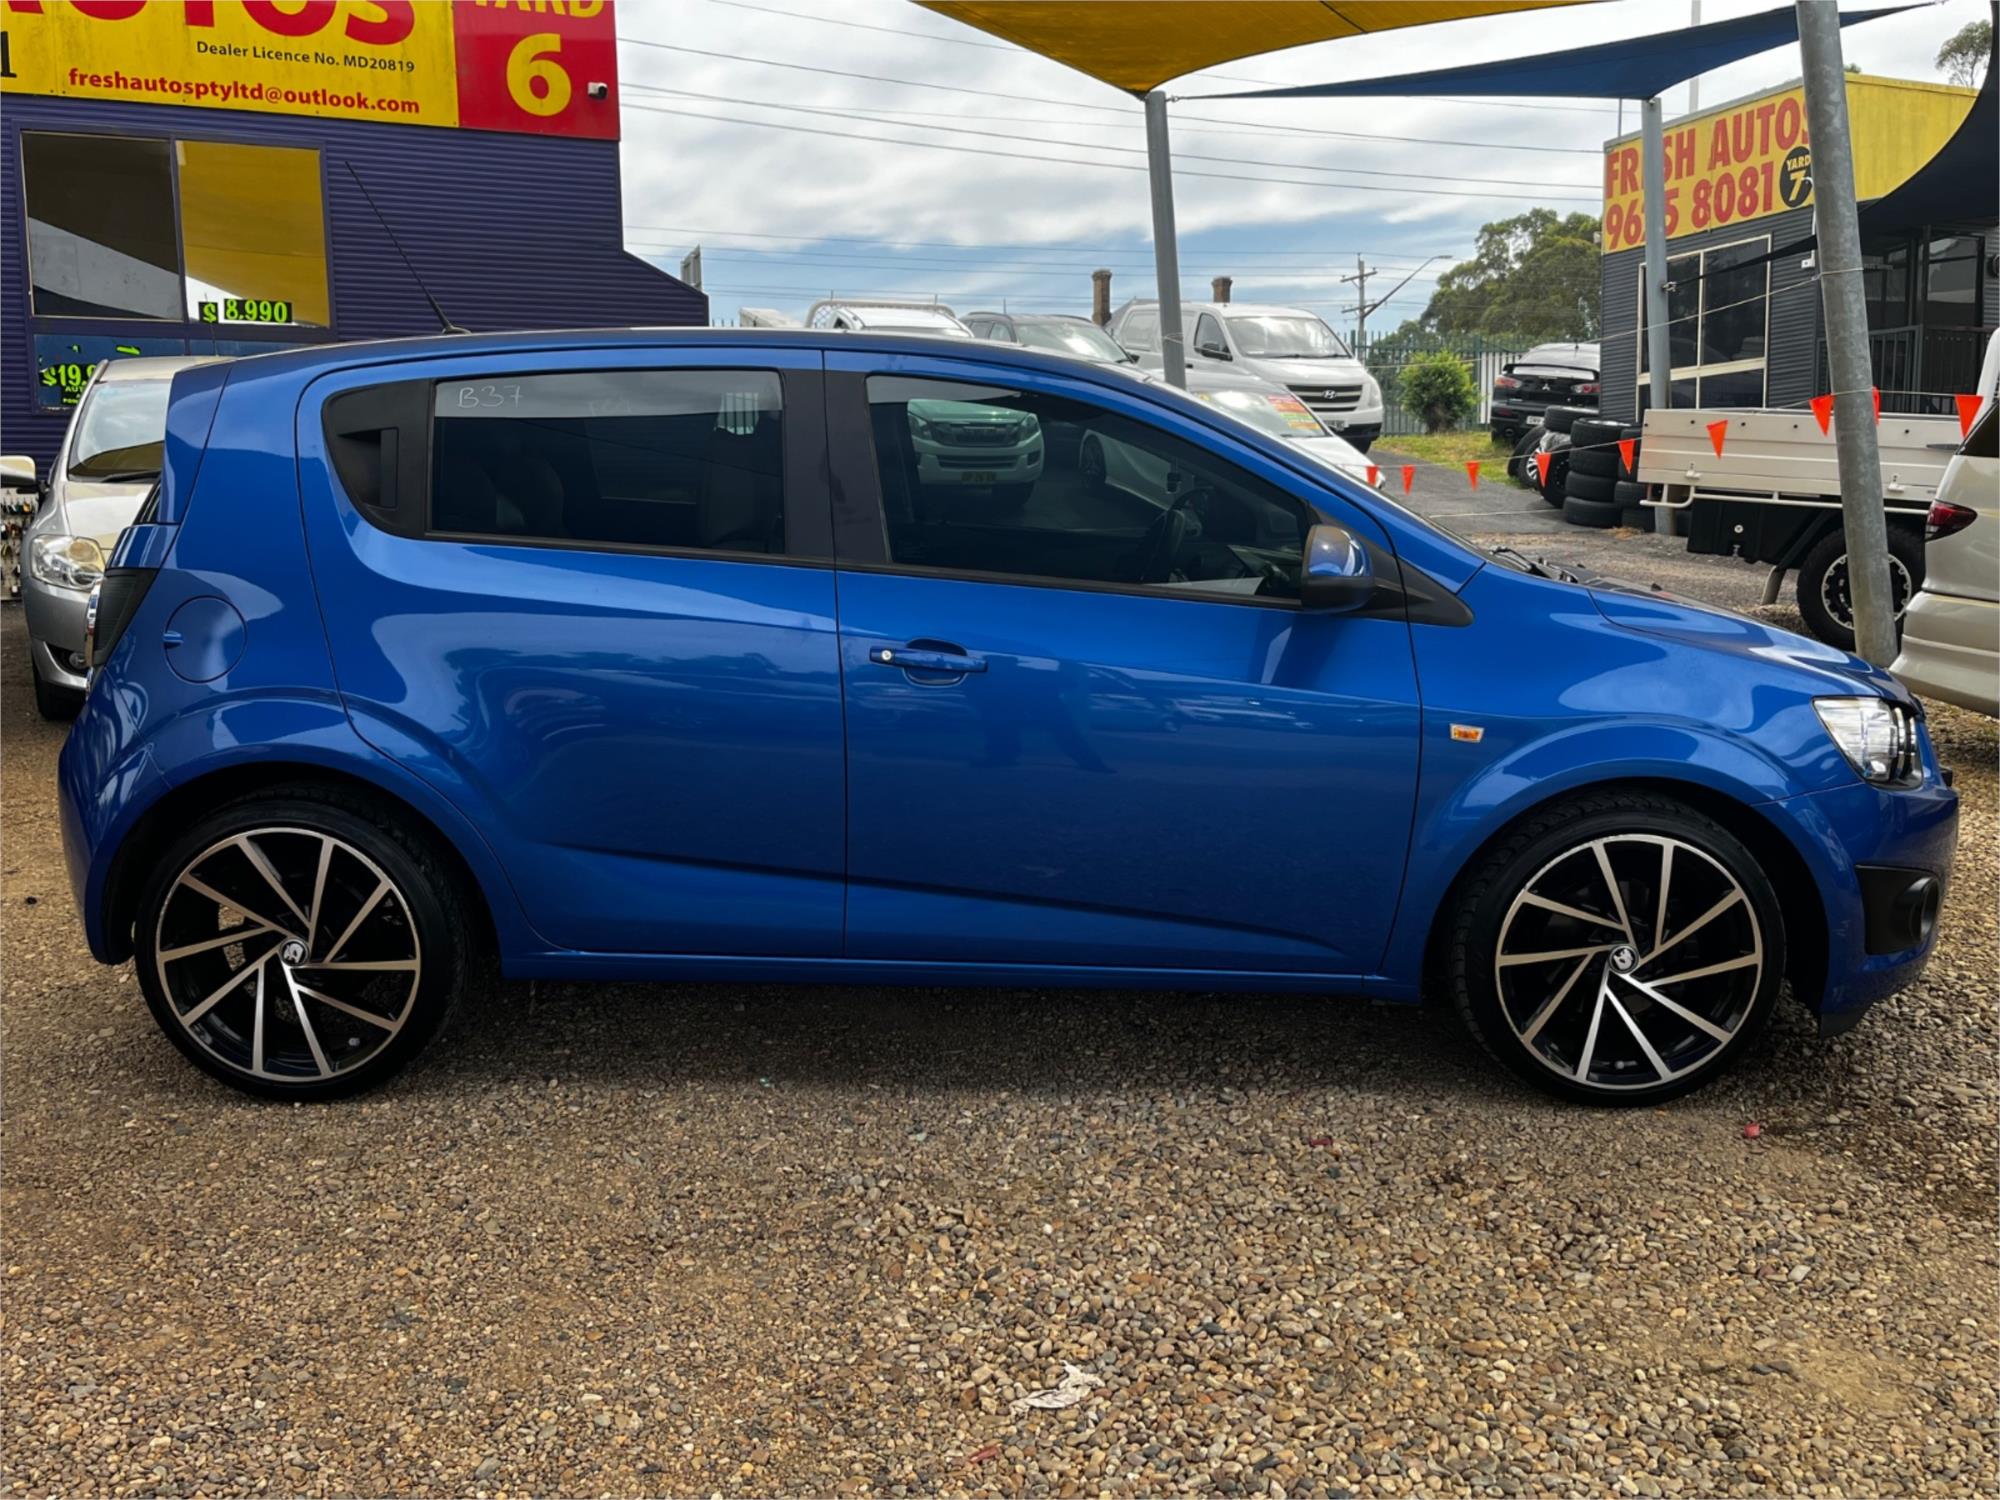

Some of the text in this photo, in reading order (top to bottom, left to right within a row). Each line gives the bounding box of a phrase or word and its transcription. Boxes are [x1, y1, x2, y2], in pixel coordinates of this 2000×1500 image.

[196, 41, 415, 73] Dealer Licence No. MD20819
[68, 68, 420, 114] freshautosptyltd@outlook.com
[506, 33, 572, 117] 6
[1605, 97, 1809, 200] FRSH AUTO
[1786, 154, 1811, 172] YARD
[1789, 170, 1806, 202] 7
[1605, 161, 1774, 251] 965 8081
[225, 299, 288, 324] 8.990
[458, 384, 524, 409] B37
